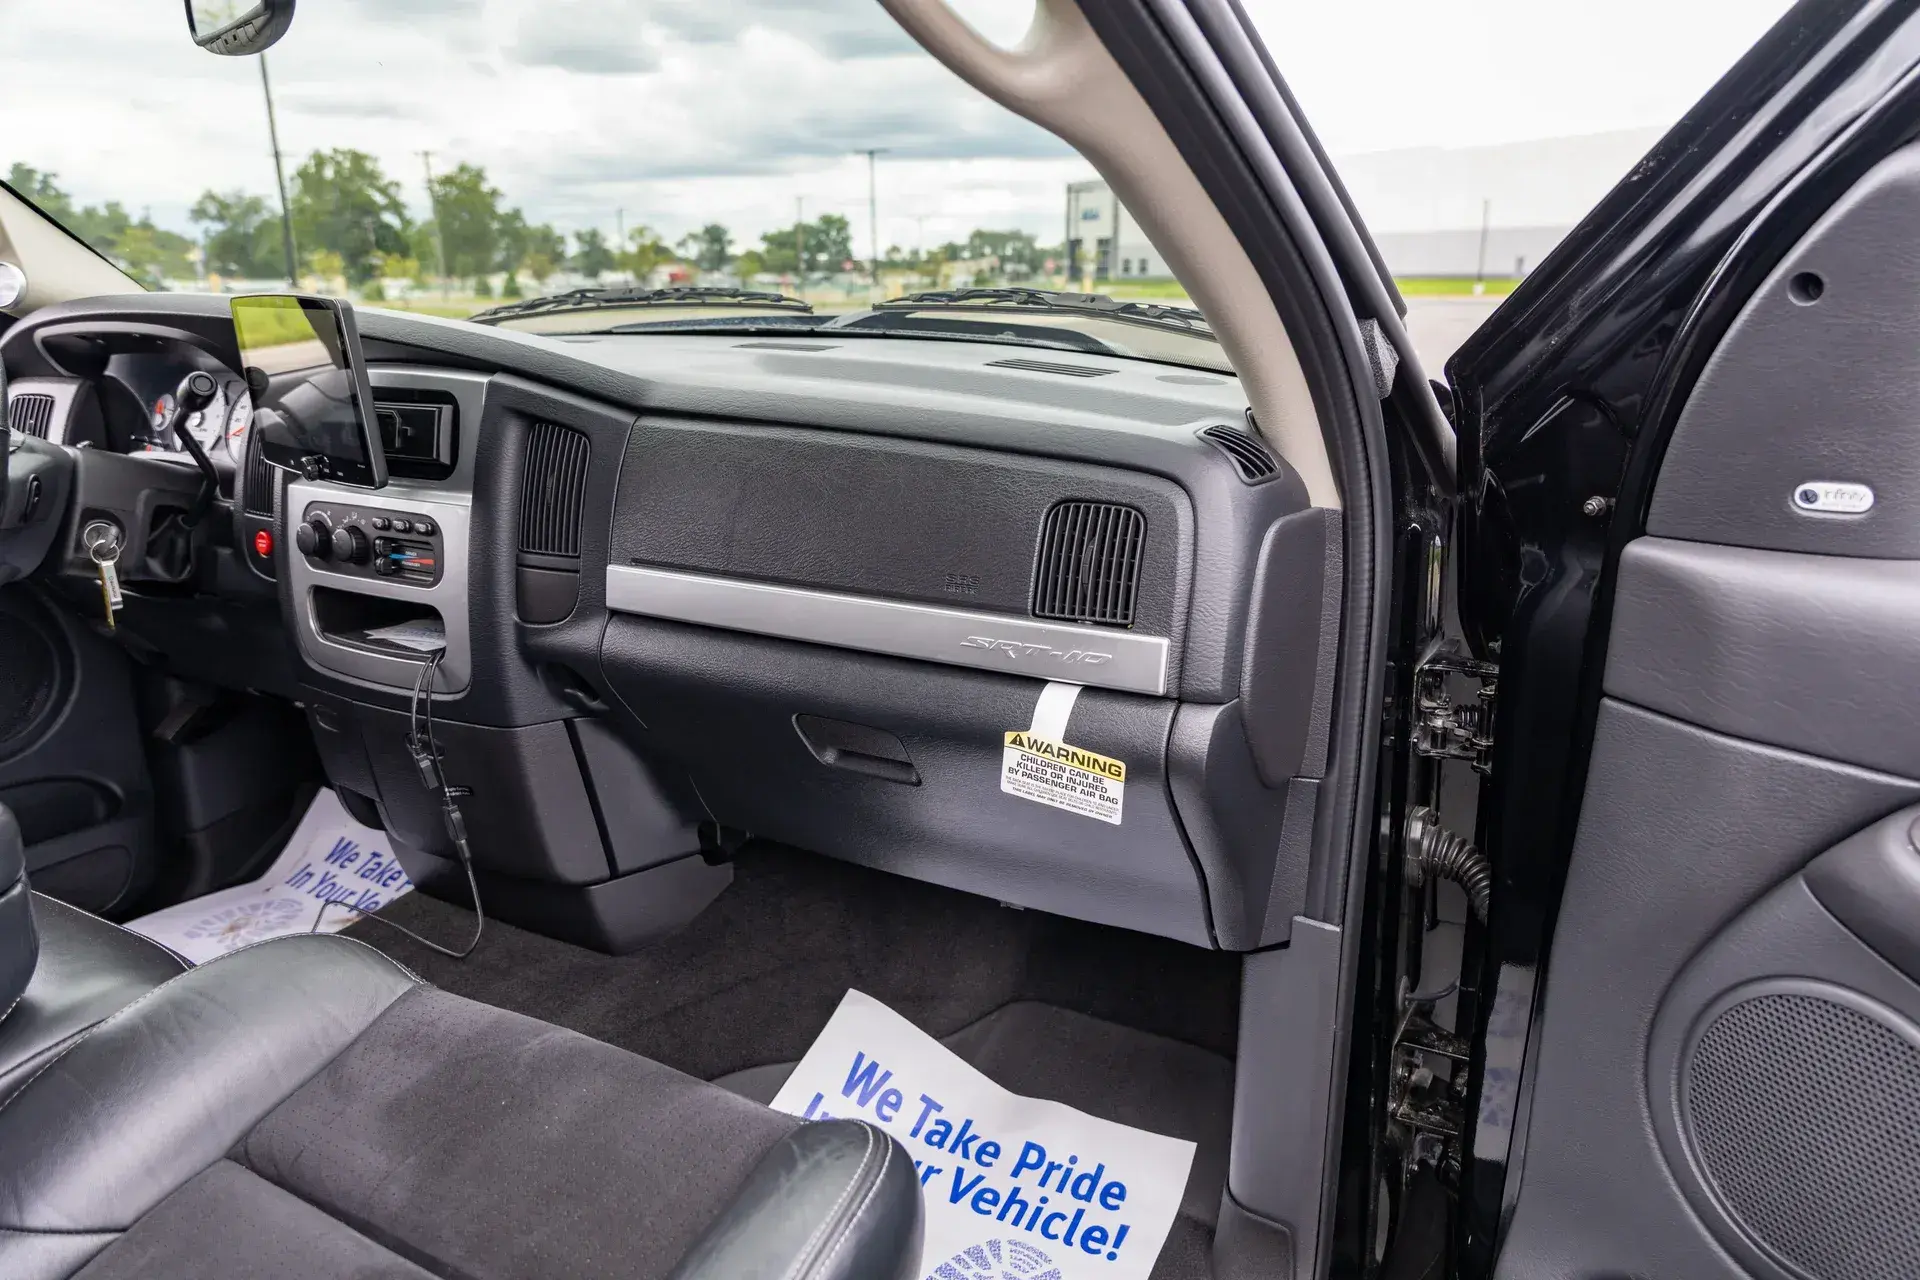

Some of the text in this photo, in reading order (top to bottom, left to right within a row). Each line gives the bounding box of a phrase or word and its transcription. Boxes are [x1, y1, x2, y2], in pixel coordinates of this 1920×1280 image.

[960, 636, 1113, 665] SRT-10
[1016, 760, 1048, 776] KILLED
[1050, 771, 1063, 781] OR
[1066, 776, 1108, 794] INJURED
[1020, 753, 1105, 785] CHILDREN CAN BE
[1027, 736, 1122, 778] WARNING
[1008, 766, 1020, 776] BY
[1021, 771, 1077, 793] PASSENGER
[1079, 788, 1096, 798] AIR
[1098, 794, 1119, 806] BAG
[324, 836, 404, 888] We Take
[285, 863, 315, 889] In
[307, 871, 357, 903] Your
[841, 1050, 1127, 1212] We Take Pride
[803, 1092, 835, 1121] I
[949, 1165, 1131, 1262] Vehicle!
